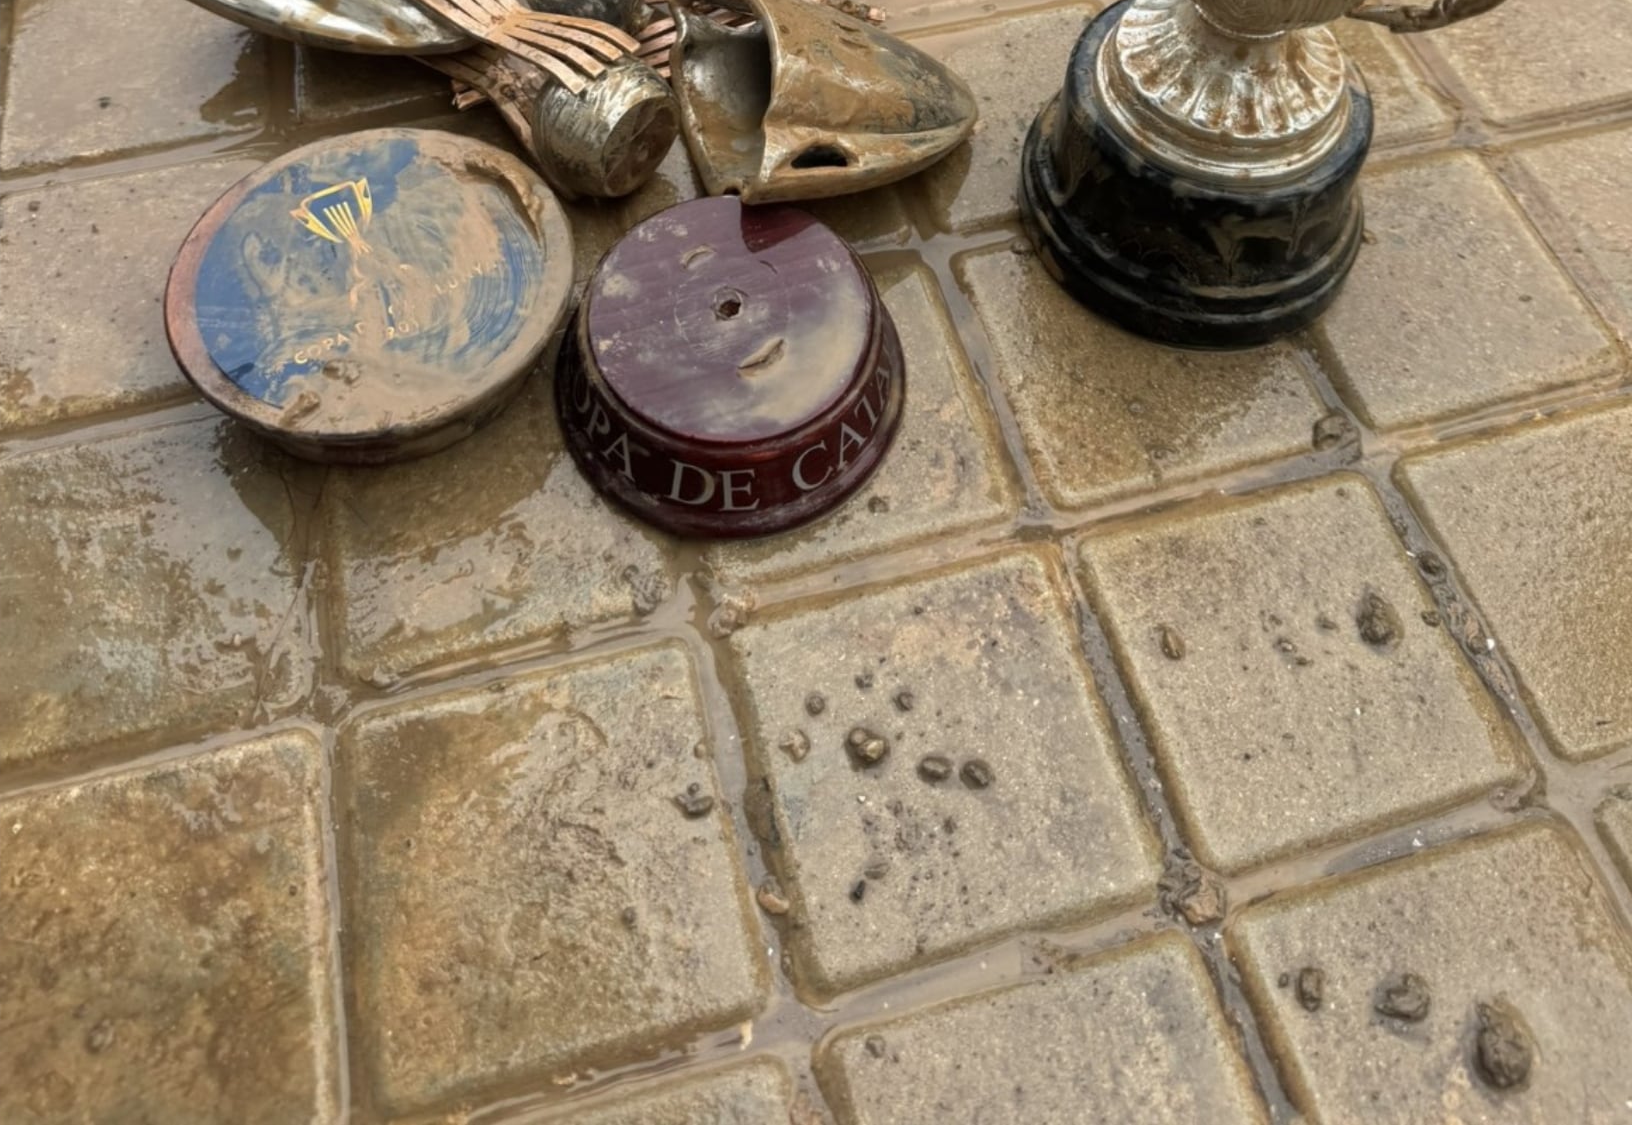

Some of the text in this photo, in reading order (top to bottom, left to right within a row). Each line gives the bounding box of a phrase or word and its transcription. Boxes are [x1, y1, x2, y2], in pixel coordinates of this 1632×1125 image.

[572, 365, 891, 513] OPA DE CATA
